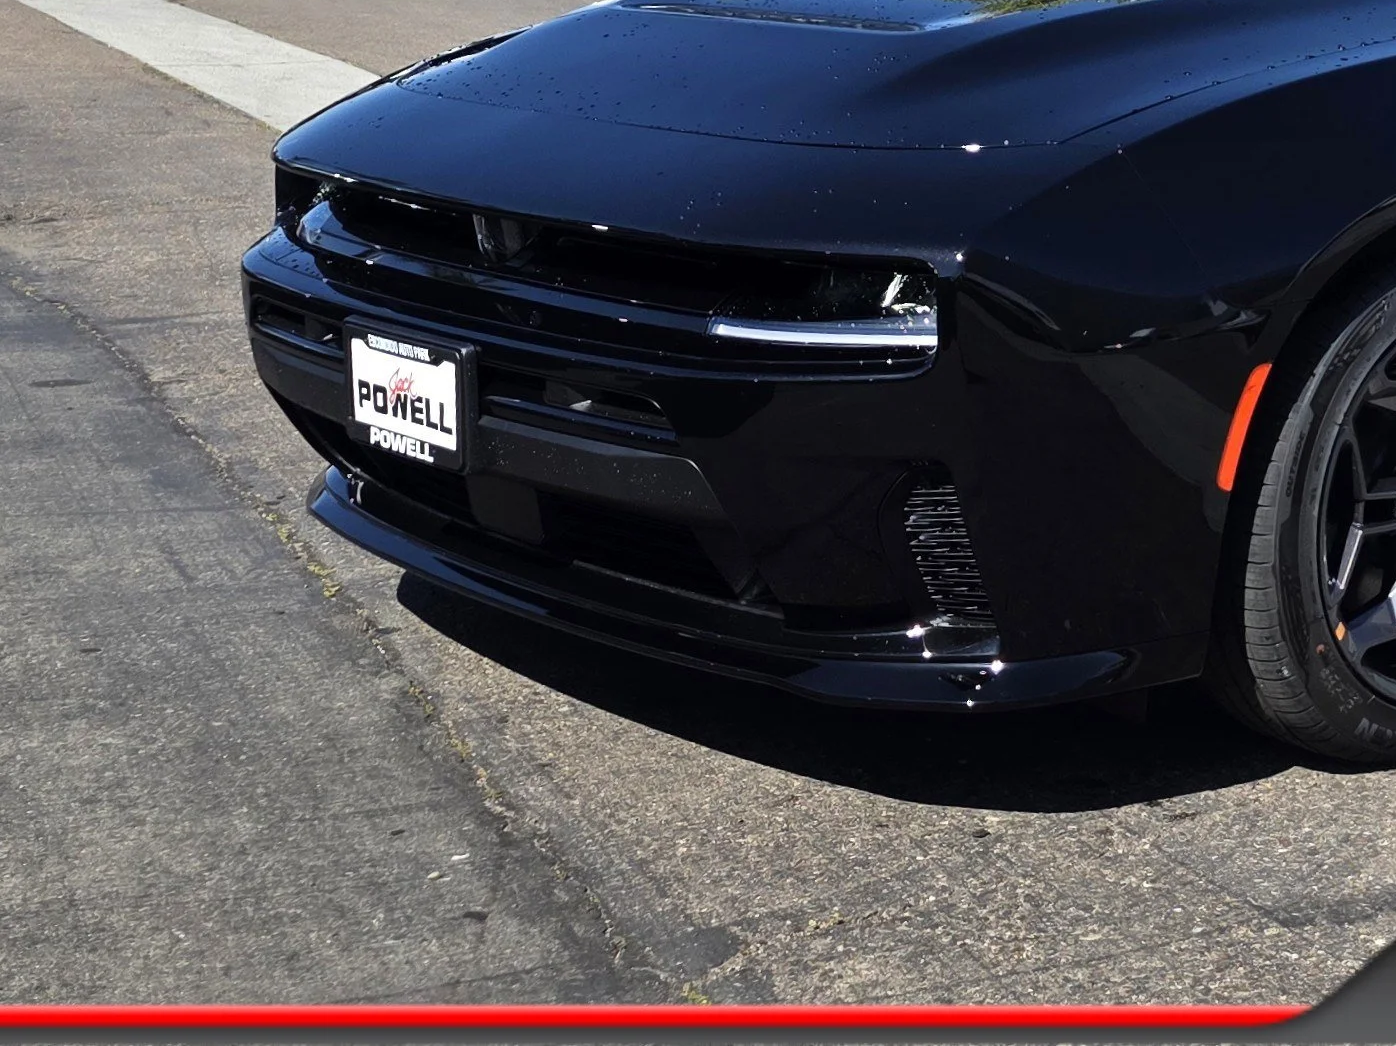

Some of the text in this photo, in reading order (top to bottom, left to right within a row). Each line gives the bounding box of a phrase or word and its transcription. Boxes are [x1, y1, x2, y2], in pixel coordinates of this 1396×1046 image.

[389, 367, 418, 406] Jack
[358, 379, 453, 435] POWELL
[369, 425, 435, 463] POWELL
